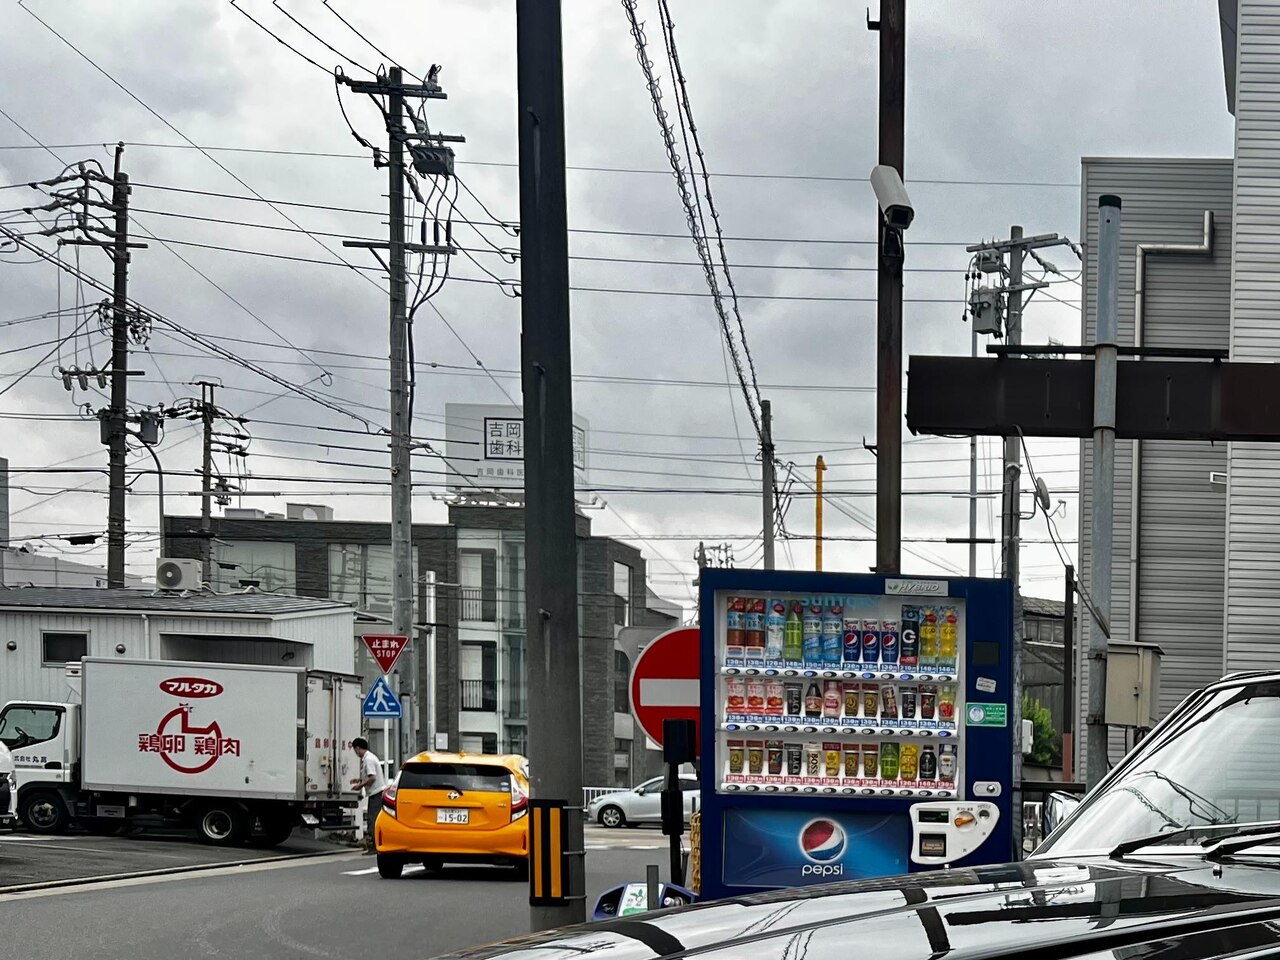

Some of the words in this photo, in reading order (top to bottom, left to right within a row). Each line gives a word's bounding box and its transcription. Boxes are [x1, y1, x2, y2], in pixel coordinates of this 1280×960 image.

[489, 422, 521, 438] 吉岡
[489, 440, 522, 455] 歯科
[371, 639, 400, 649] 止まれ
[376, 650, 396, 658] STOP
[166, 681, 217, 694] マルタカ
[138, 733, 186, 754] 鶏卵
[194, 736, 240, 757] 鶏肉
[802, 863, 843, 877] pepsi
